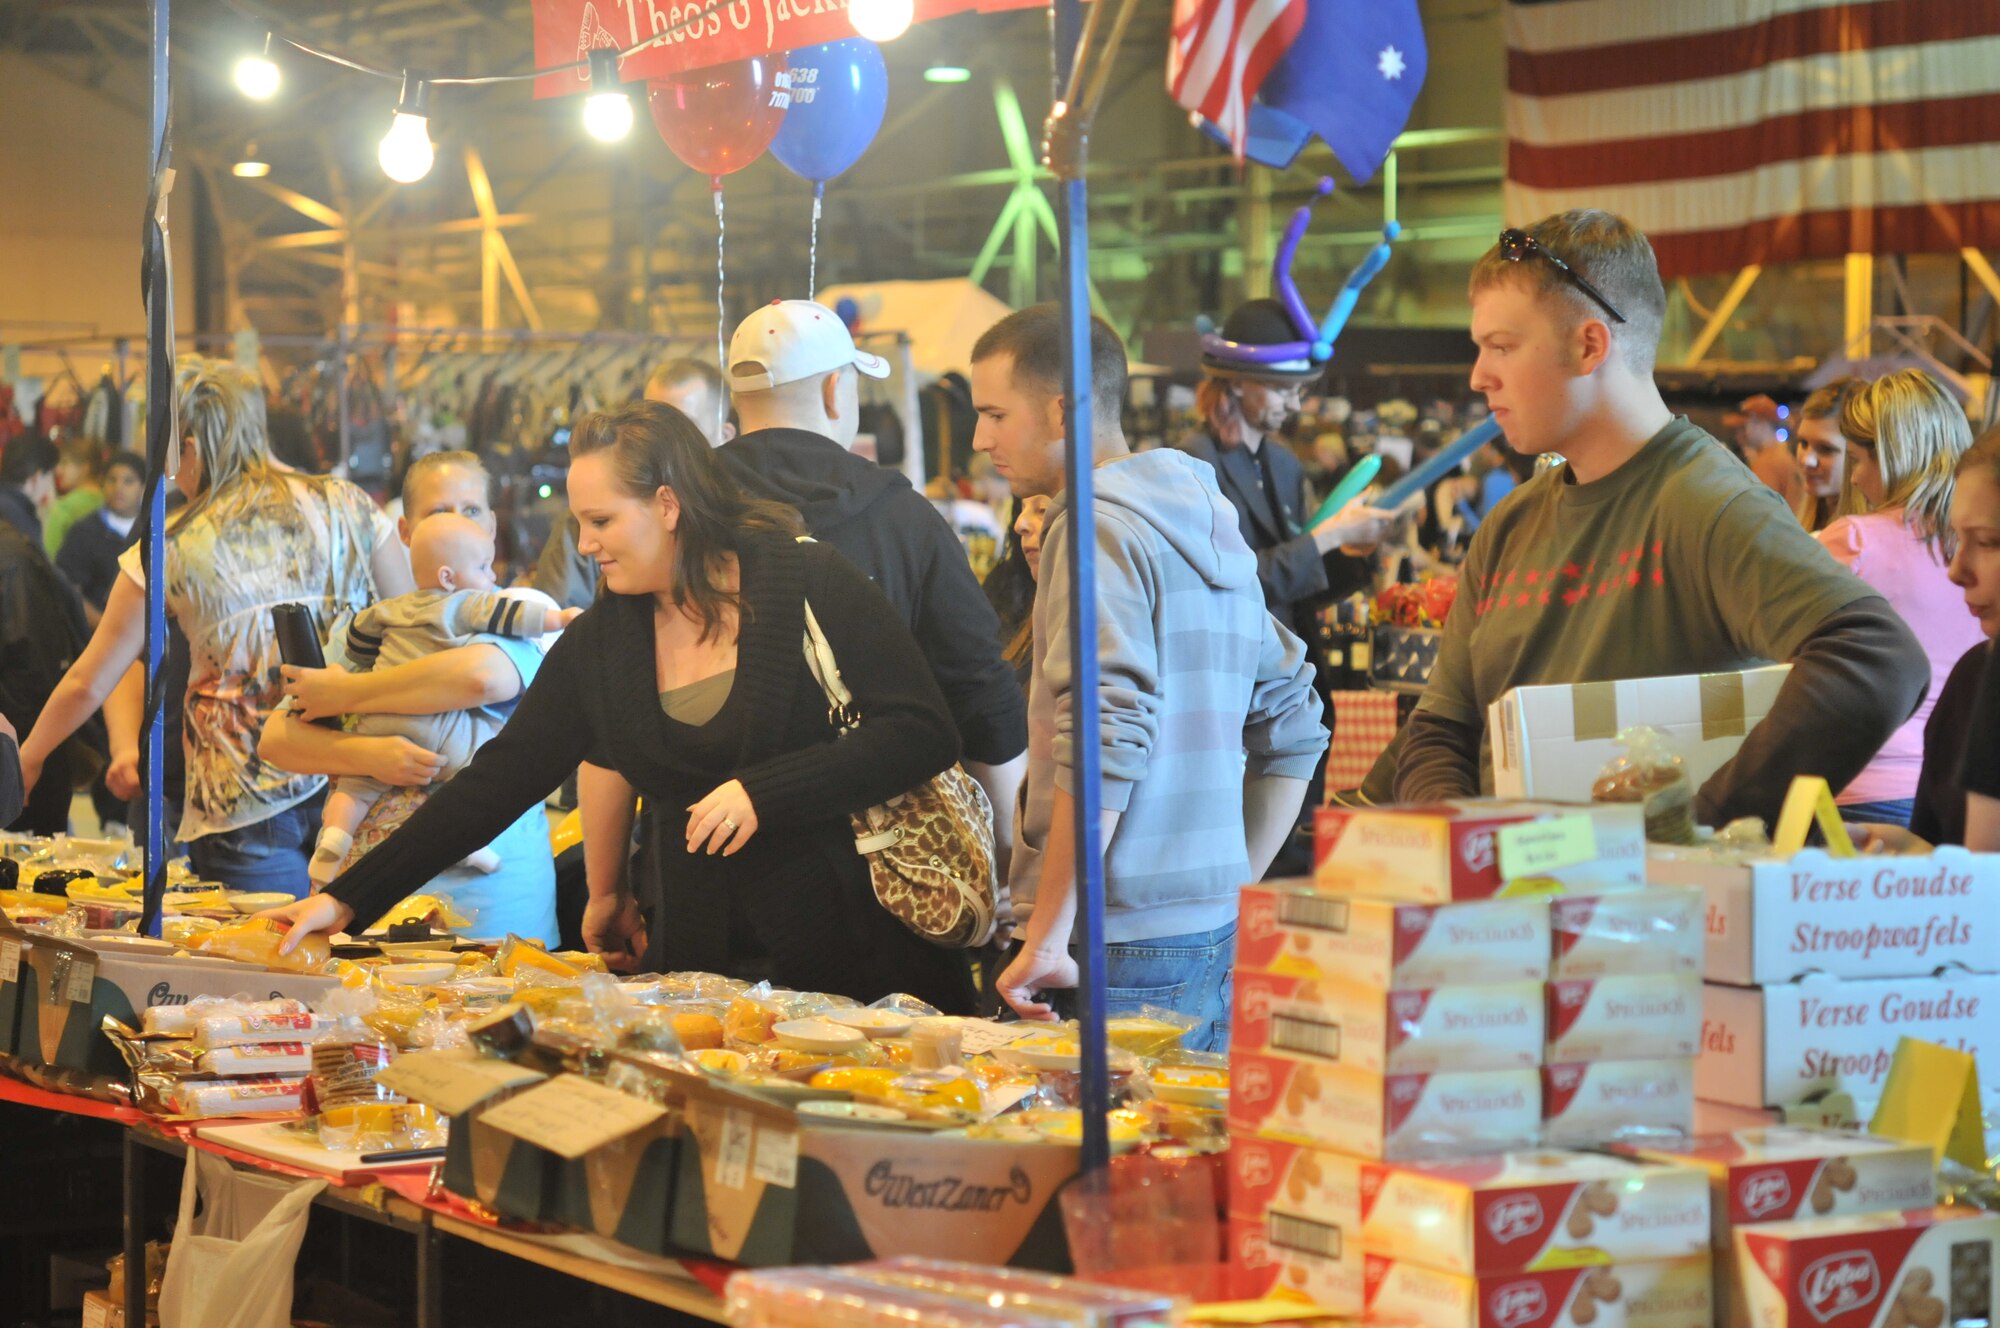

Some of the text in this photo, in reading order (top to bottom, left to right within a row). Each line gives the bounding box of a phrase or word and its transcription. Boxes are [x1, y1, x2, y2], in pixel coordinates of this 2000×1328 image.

[1790, 866, 1974, 902] Verse Goudse
[1790, 915, 1973, 960] Stroopwafels
[1799, 990, 1980, 1029] Verse Goudse
[1811, 1261, 1871, 1306] Lotus
